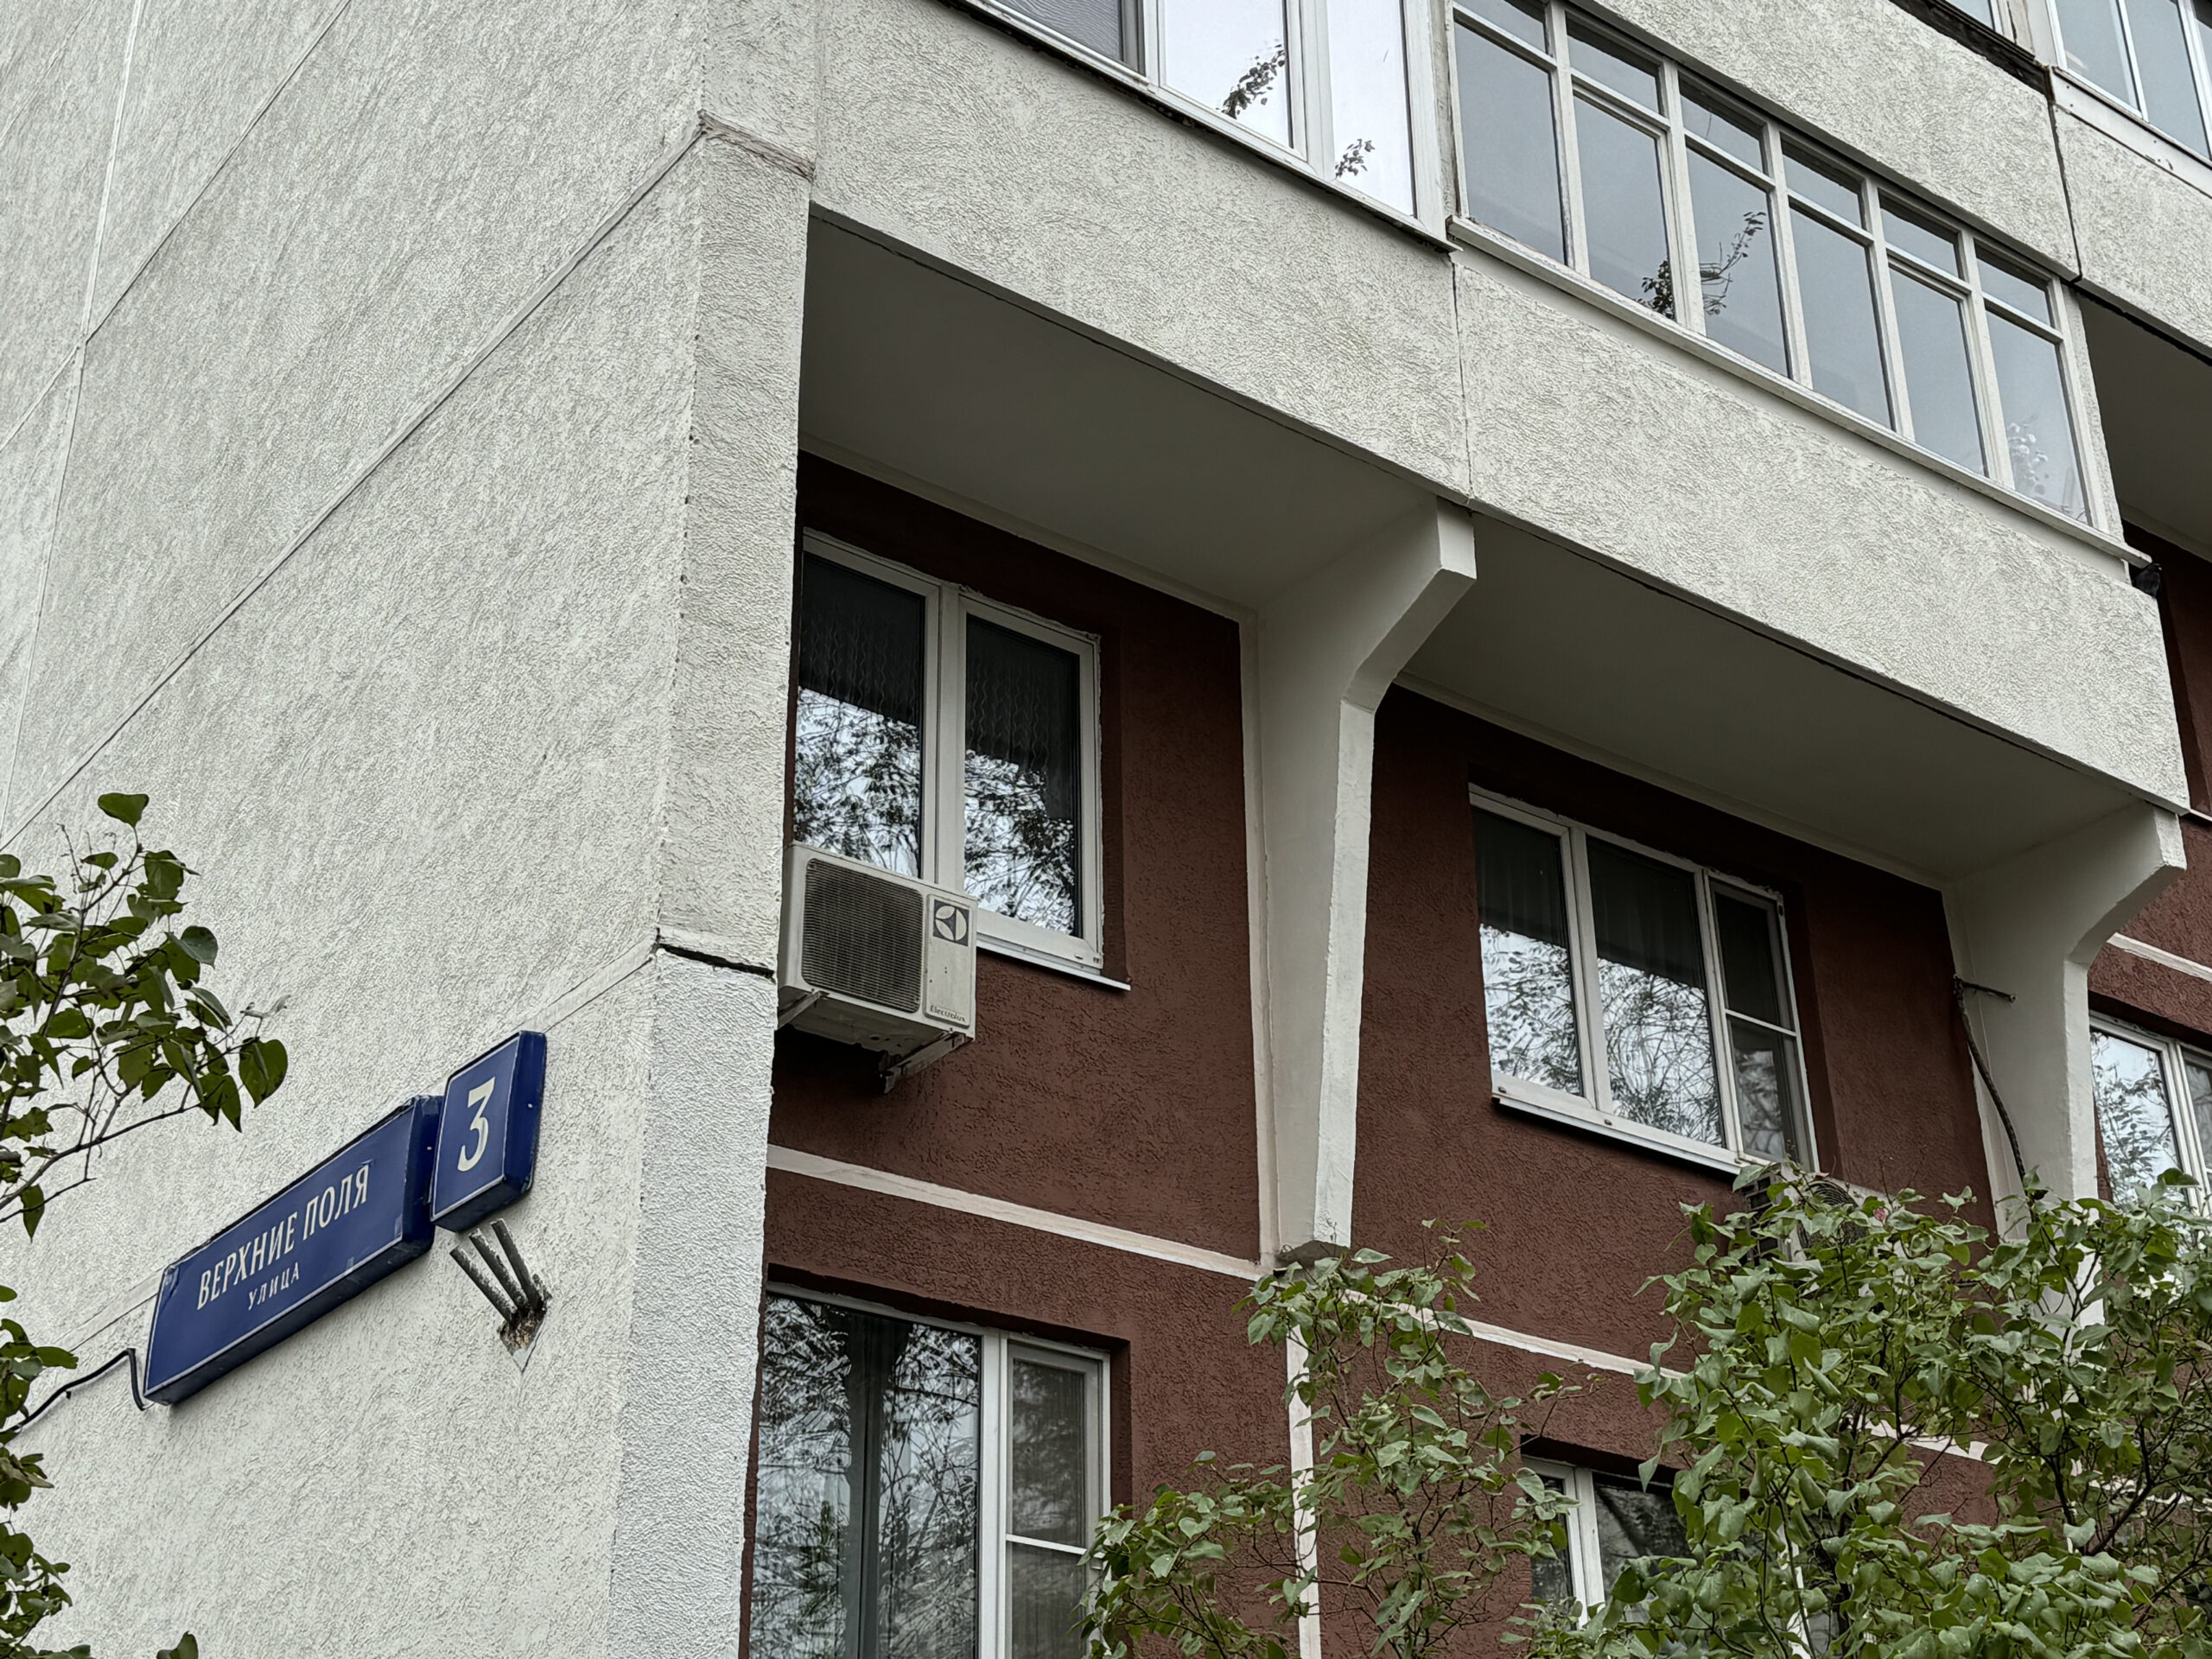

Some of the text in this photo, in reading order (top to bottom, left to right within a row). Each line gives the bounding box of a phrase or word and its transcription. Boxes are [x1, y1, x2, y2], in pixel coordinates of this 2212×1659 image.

[930, 1005, 966, 1023] Electrolux
[457, 1077, 496, 1173] 3
[197, 1165, 370, 1311] ВЕРХНИЕ ПОЛЯ
[247, 1262, 300, 1311] УЛИЦА
